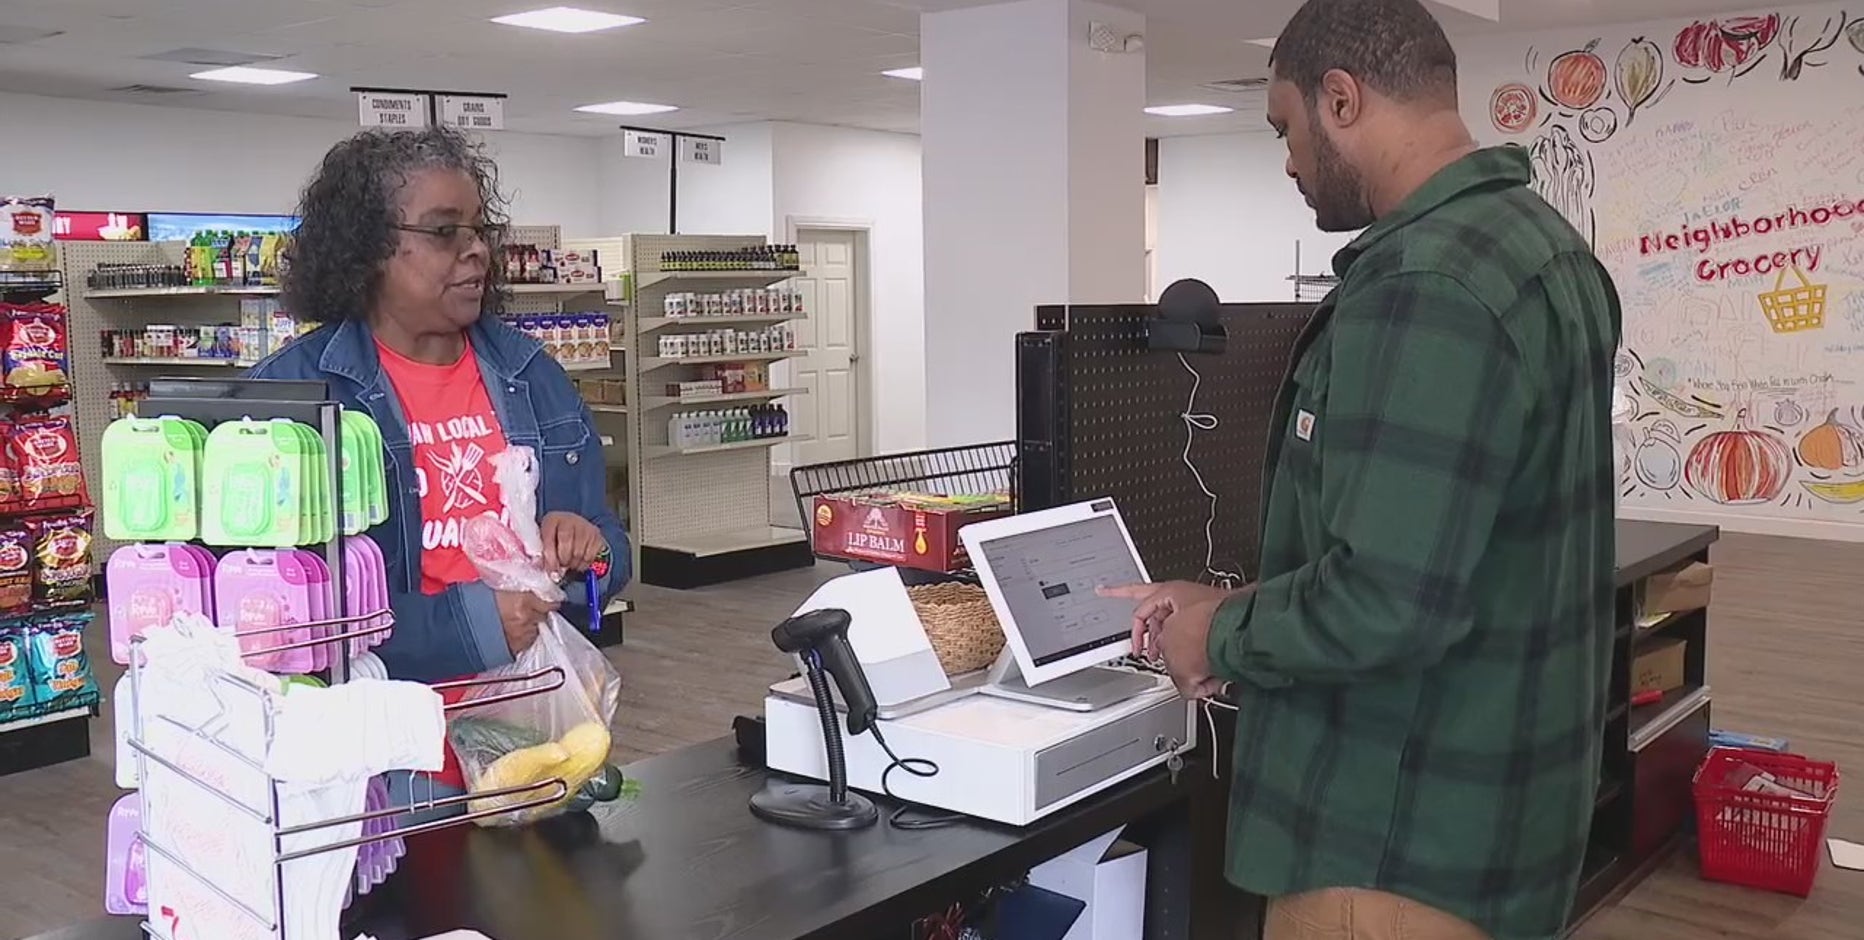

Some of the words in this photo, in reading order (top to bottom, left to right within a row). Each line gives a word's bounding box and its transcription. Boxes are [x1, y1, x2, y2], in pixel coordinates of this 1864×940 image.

[372, 98, 411, 110] CONDIMENTS
[1695, 245, 1821, 282] Grocery
[408, 422, 434, 446] AN
[436, 415, 493, 442] LOCAL
[848, 531, 868, 547] LIP
[869, 535, 905, 553] BALM
